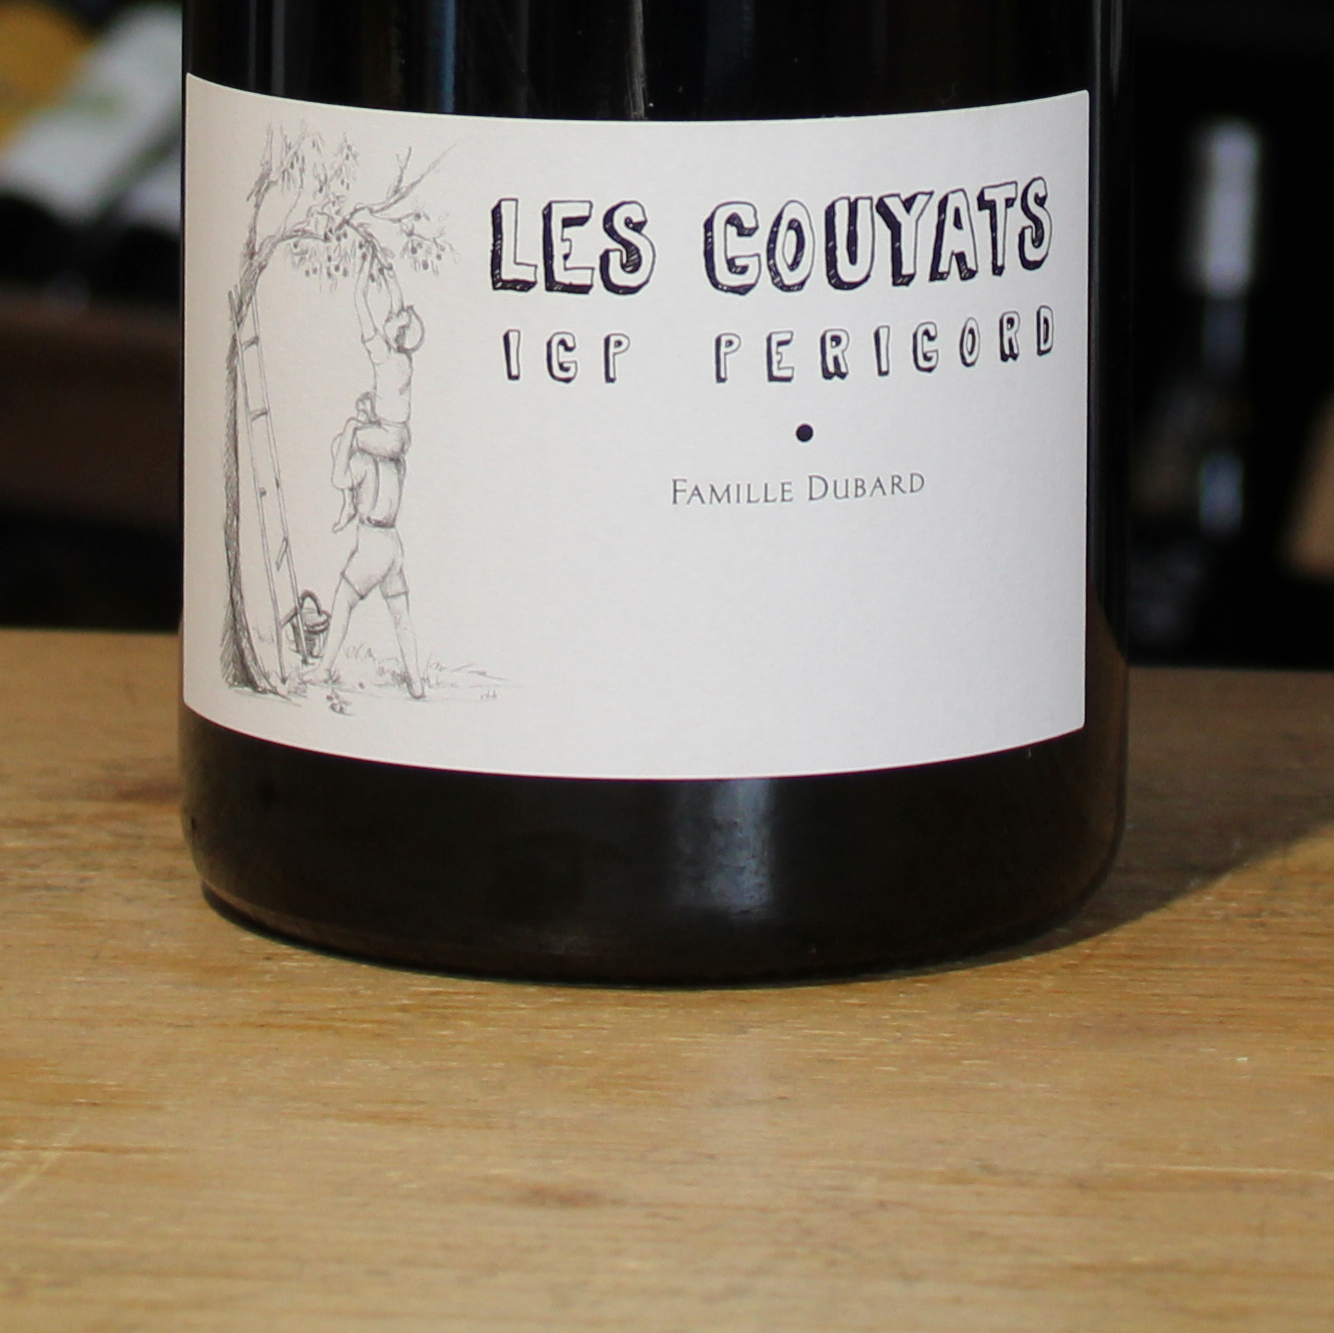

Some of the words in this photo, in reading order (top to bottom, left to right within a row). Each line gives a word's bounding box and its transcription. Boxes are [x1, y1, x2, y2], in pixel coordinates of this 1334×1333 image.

[490, 197, 657, 296] LES
[703, 175, 1053, 296] GOUYATS
[503, 328, 631, 384] IGP
[715, 304, 1054, 384] PERIGORD
